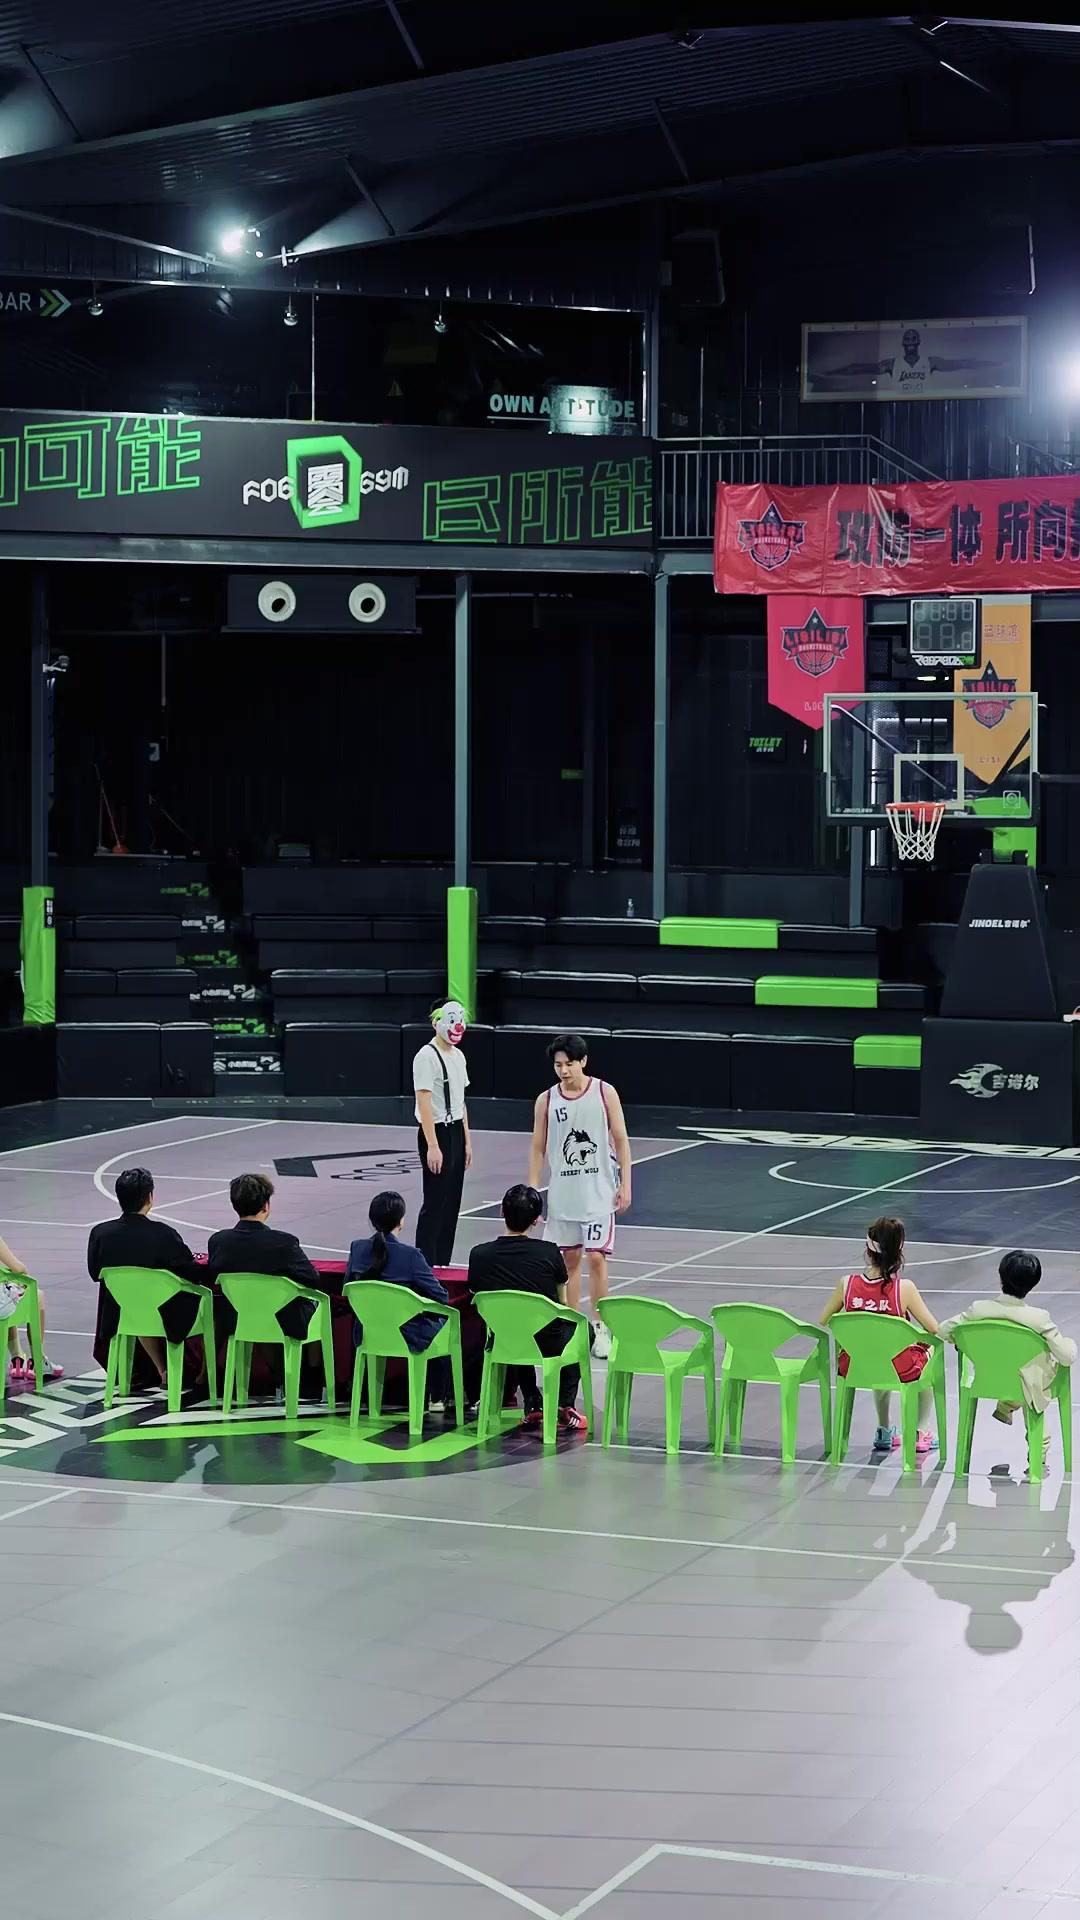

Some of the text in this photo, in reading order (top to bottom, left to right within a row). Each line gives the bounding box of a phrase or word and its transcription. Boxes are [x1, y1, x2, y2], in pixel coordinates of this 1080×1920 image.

[489, 393, 534, 414] OWN
[0, 417, 201, 507] 可能
[749, 737, 782, 747] TOILET
[555, 1106, 568, 1123] 15
[587, 1224, 602, 1241] 15
[851, 1296, 892, 1311] 梦之队
